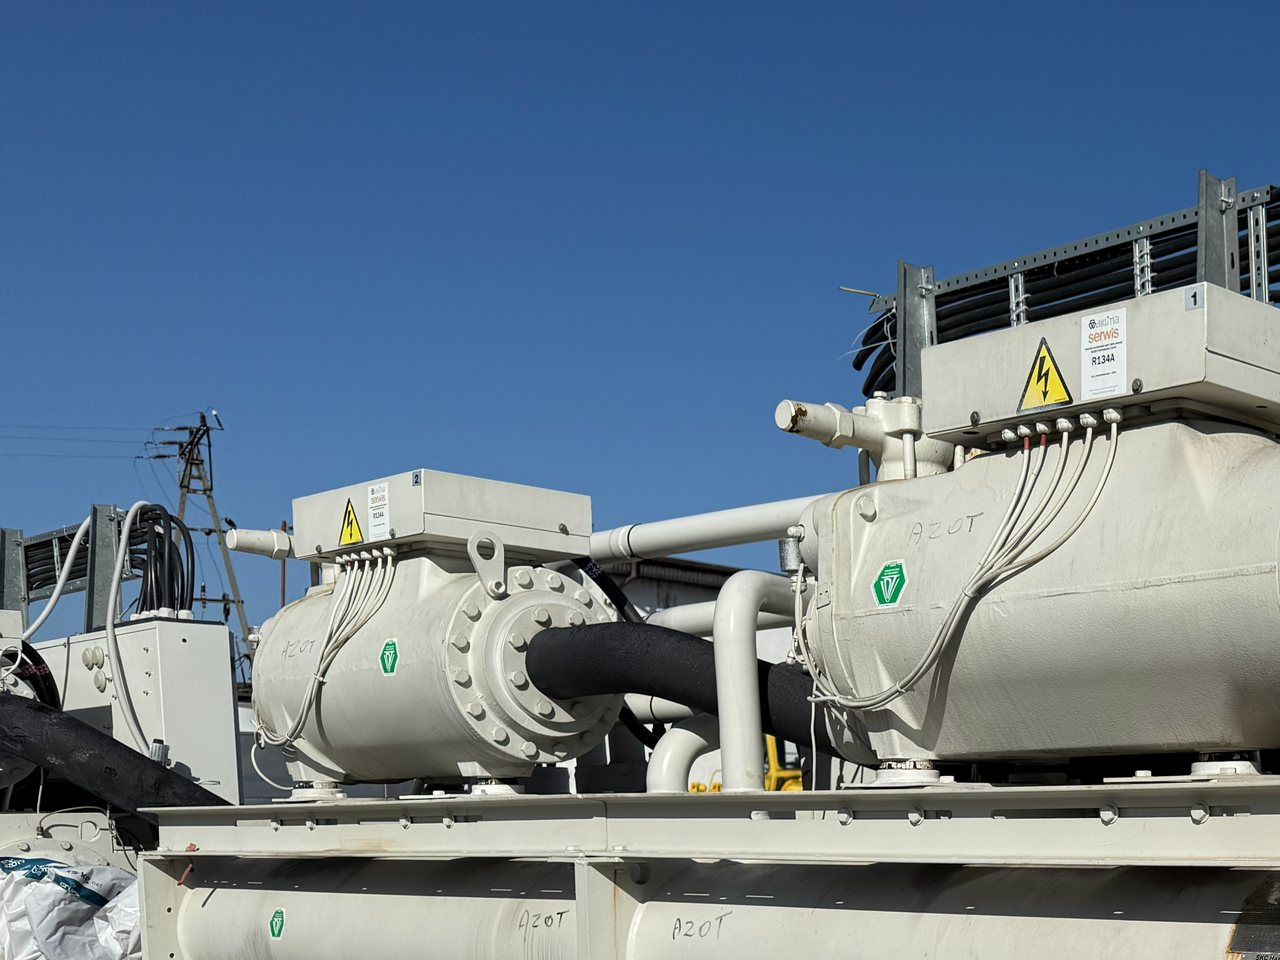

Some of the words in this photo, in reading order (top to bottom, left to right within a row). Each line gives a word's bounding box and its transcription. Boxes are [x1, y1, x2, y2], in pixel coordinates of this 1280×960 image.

[1190, 291, 1198, 306] 1
[1088, 327, 1120, 344] serwis
[1091, 353, 1116, 367] R134A
[413, 474, 420, 484] 2
